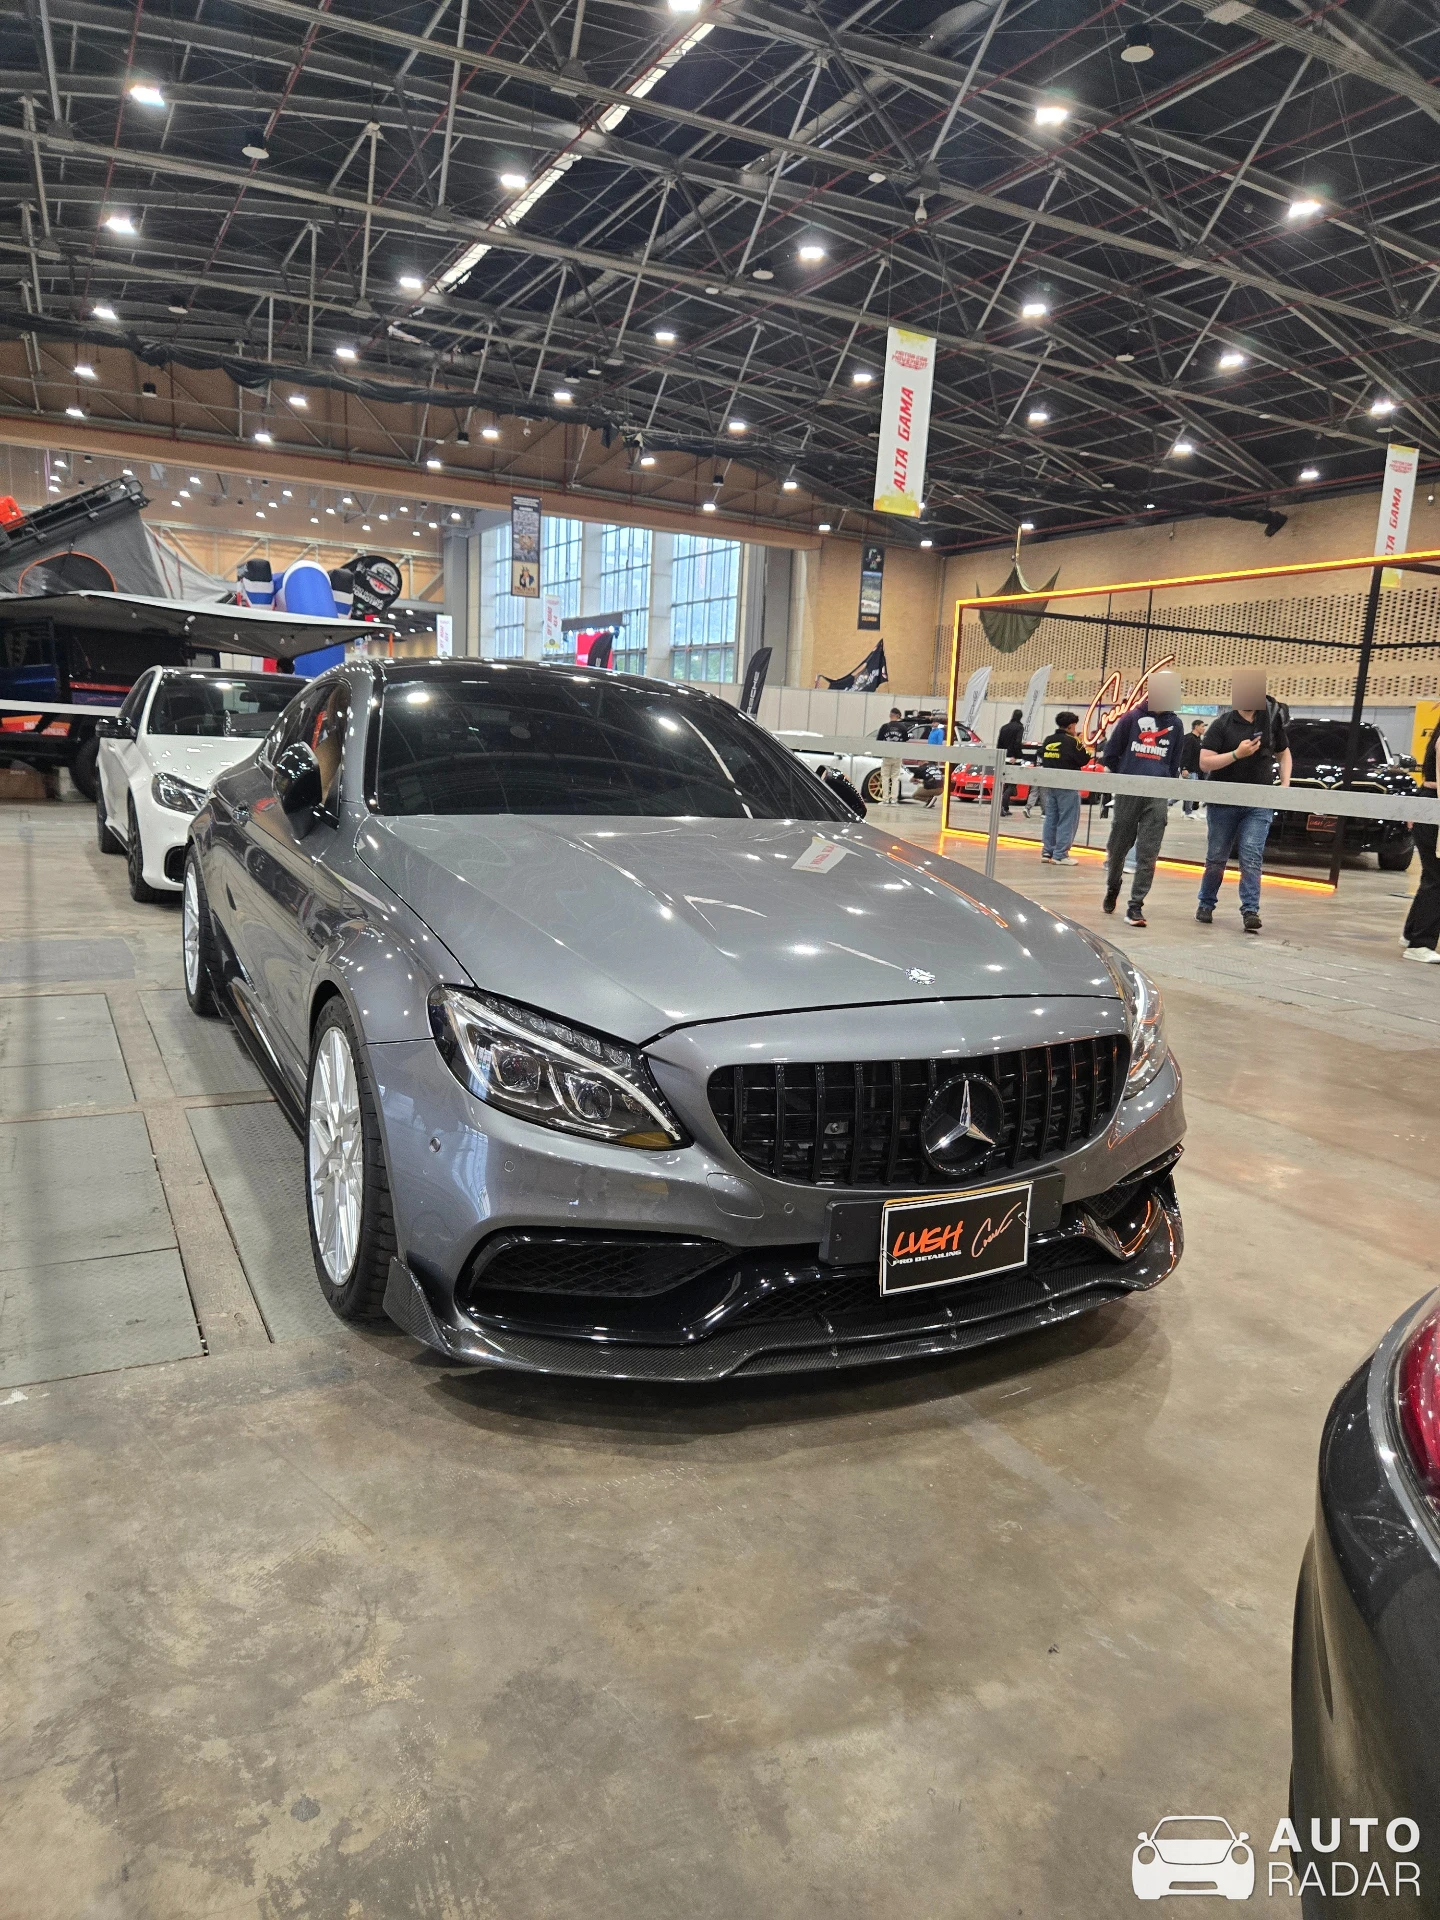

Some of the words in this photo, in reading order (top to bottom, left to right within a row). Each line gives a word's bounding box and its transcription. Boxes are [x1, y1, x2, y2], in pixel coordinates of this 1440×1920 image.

[897, 386, 914, 442] GAMA
[893, 447, 908, 493] ALTA
[1389, 487, 1402, 530] GAMA
[892, 1257, 914, 1265] PRO
[914, 1249, 962, 1263] DETAILING
[893, 1220, 964, 1258] LUSH
